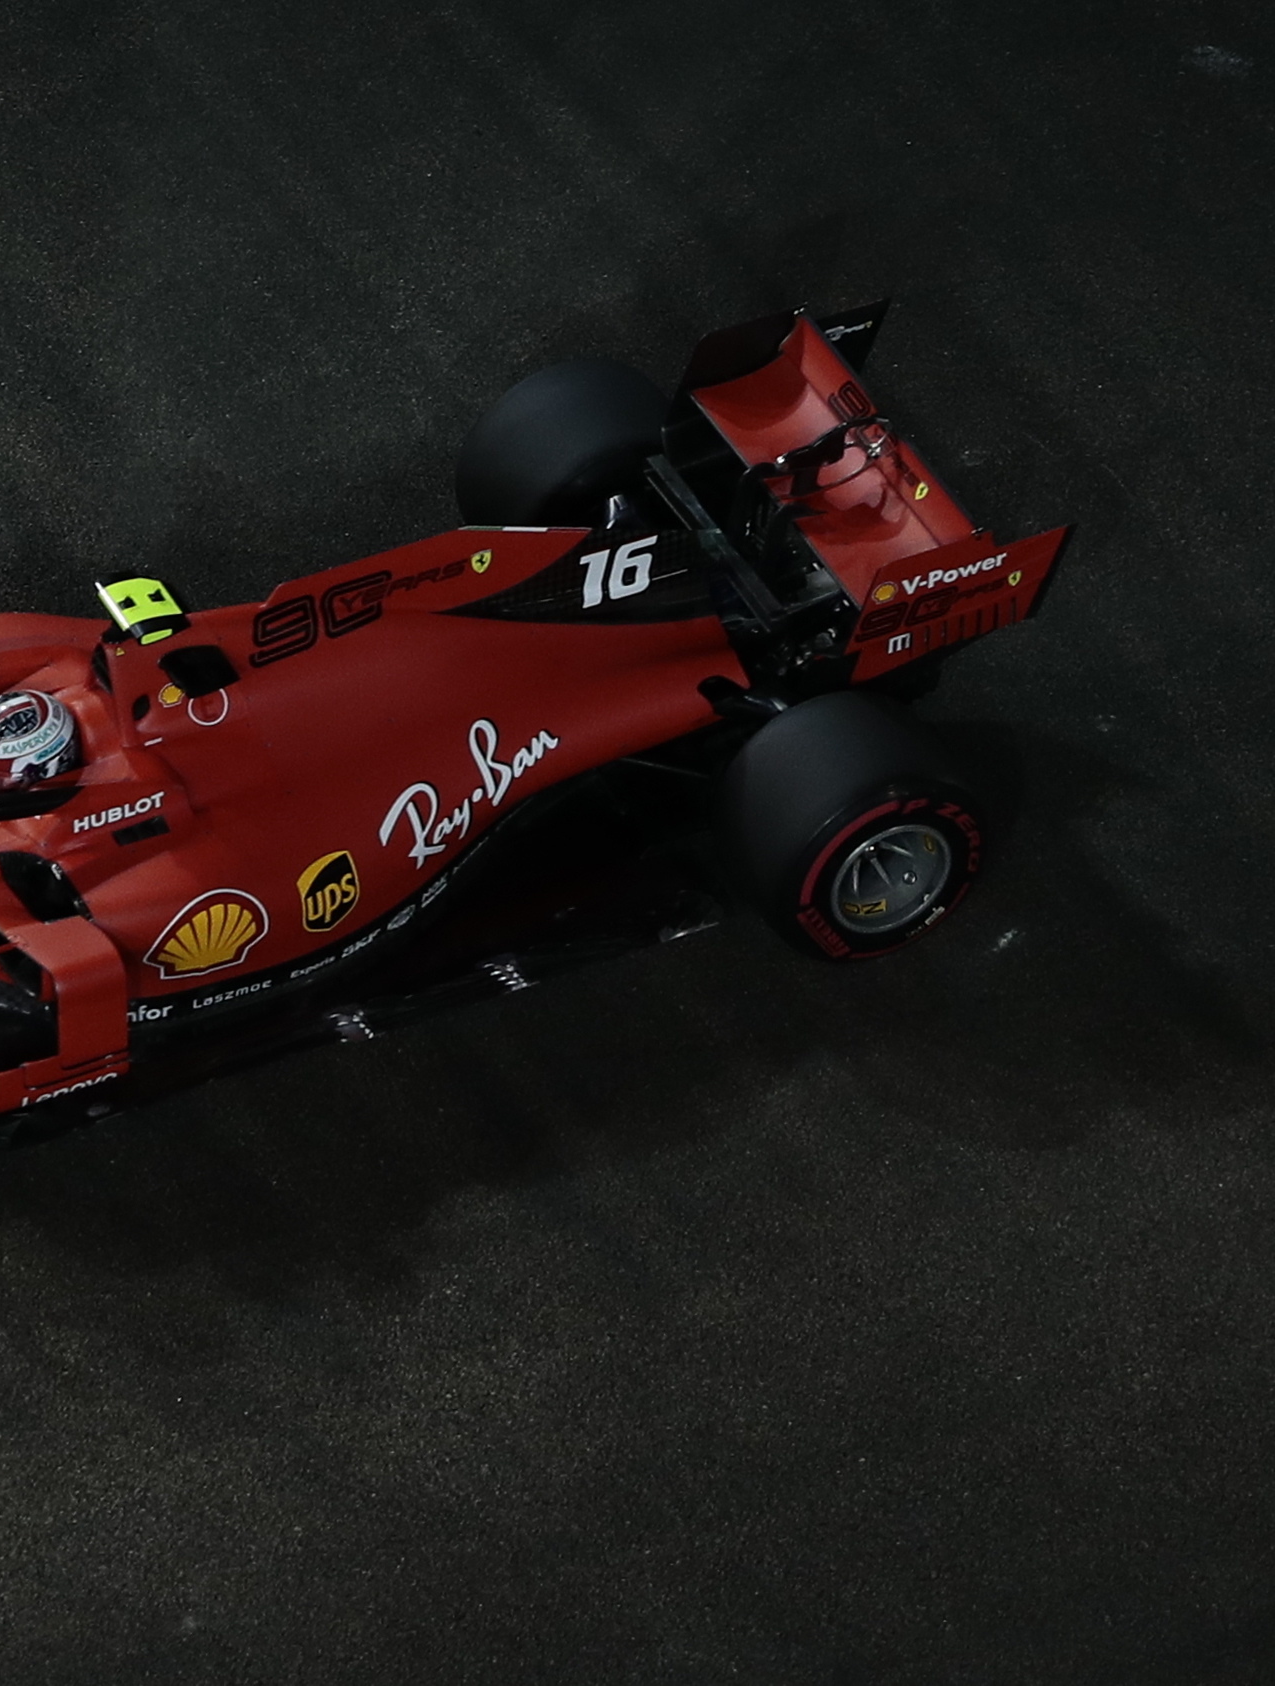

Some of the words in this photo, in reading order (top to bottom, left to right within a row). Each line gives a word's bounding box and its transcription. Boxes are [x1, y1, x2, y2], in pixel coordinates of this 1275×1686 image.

[579, 534, 659, 610] 16
[901, 551, 1008, 596] V-Power
[73, 791, 166, 833] HUBLOT
[126, 1004, 174, 1023] nfor
